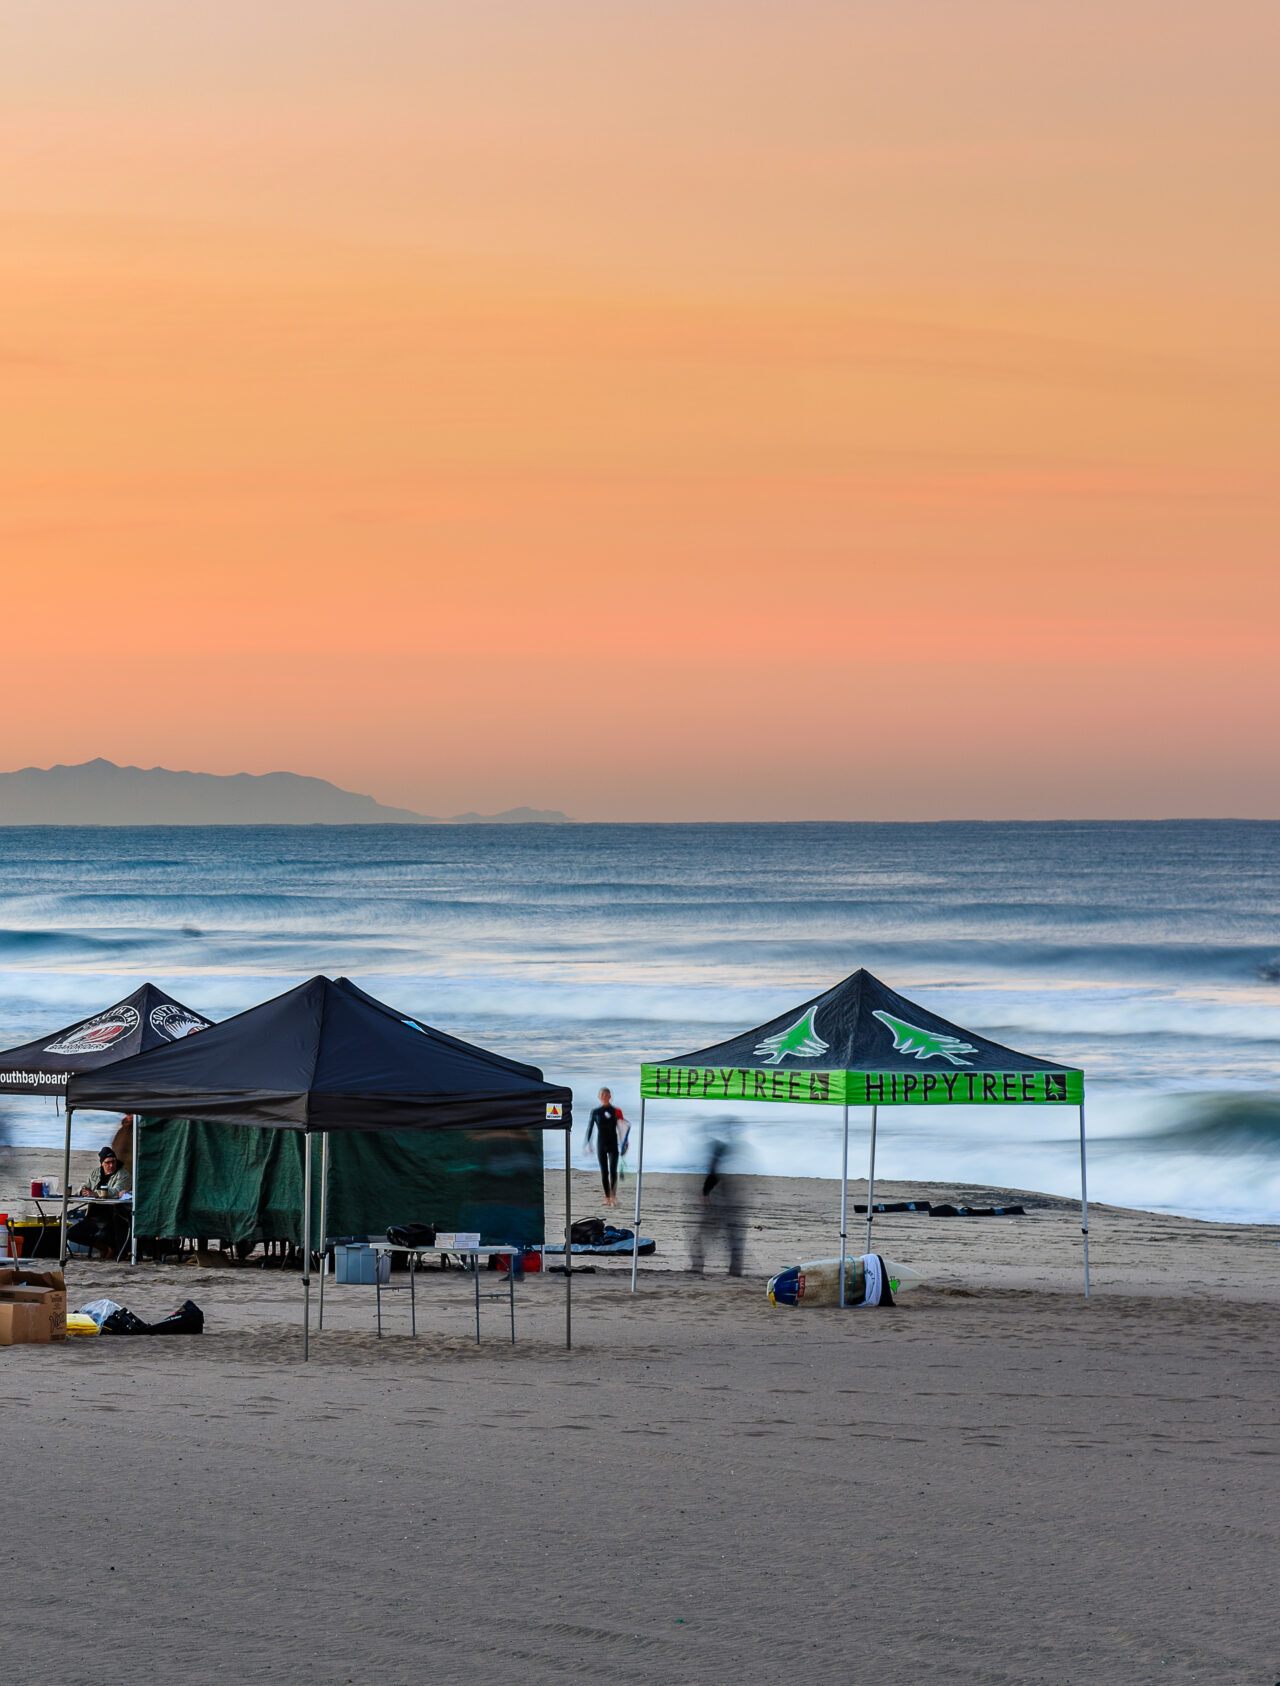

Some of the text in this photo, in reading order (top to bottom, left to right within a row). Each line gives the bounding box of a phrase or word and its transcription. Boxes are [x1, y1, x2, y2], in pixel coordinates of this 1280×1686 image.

[124, 1010, 137, 1026] BAY
[656, 1068, 802, 1100] HIPPYTREE
[865, 1073, 1036, 1102] HIPPYTREE
